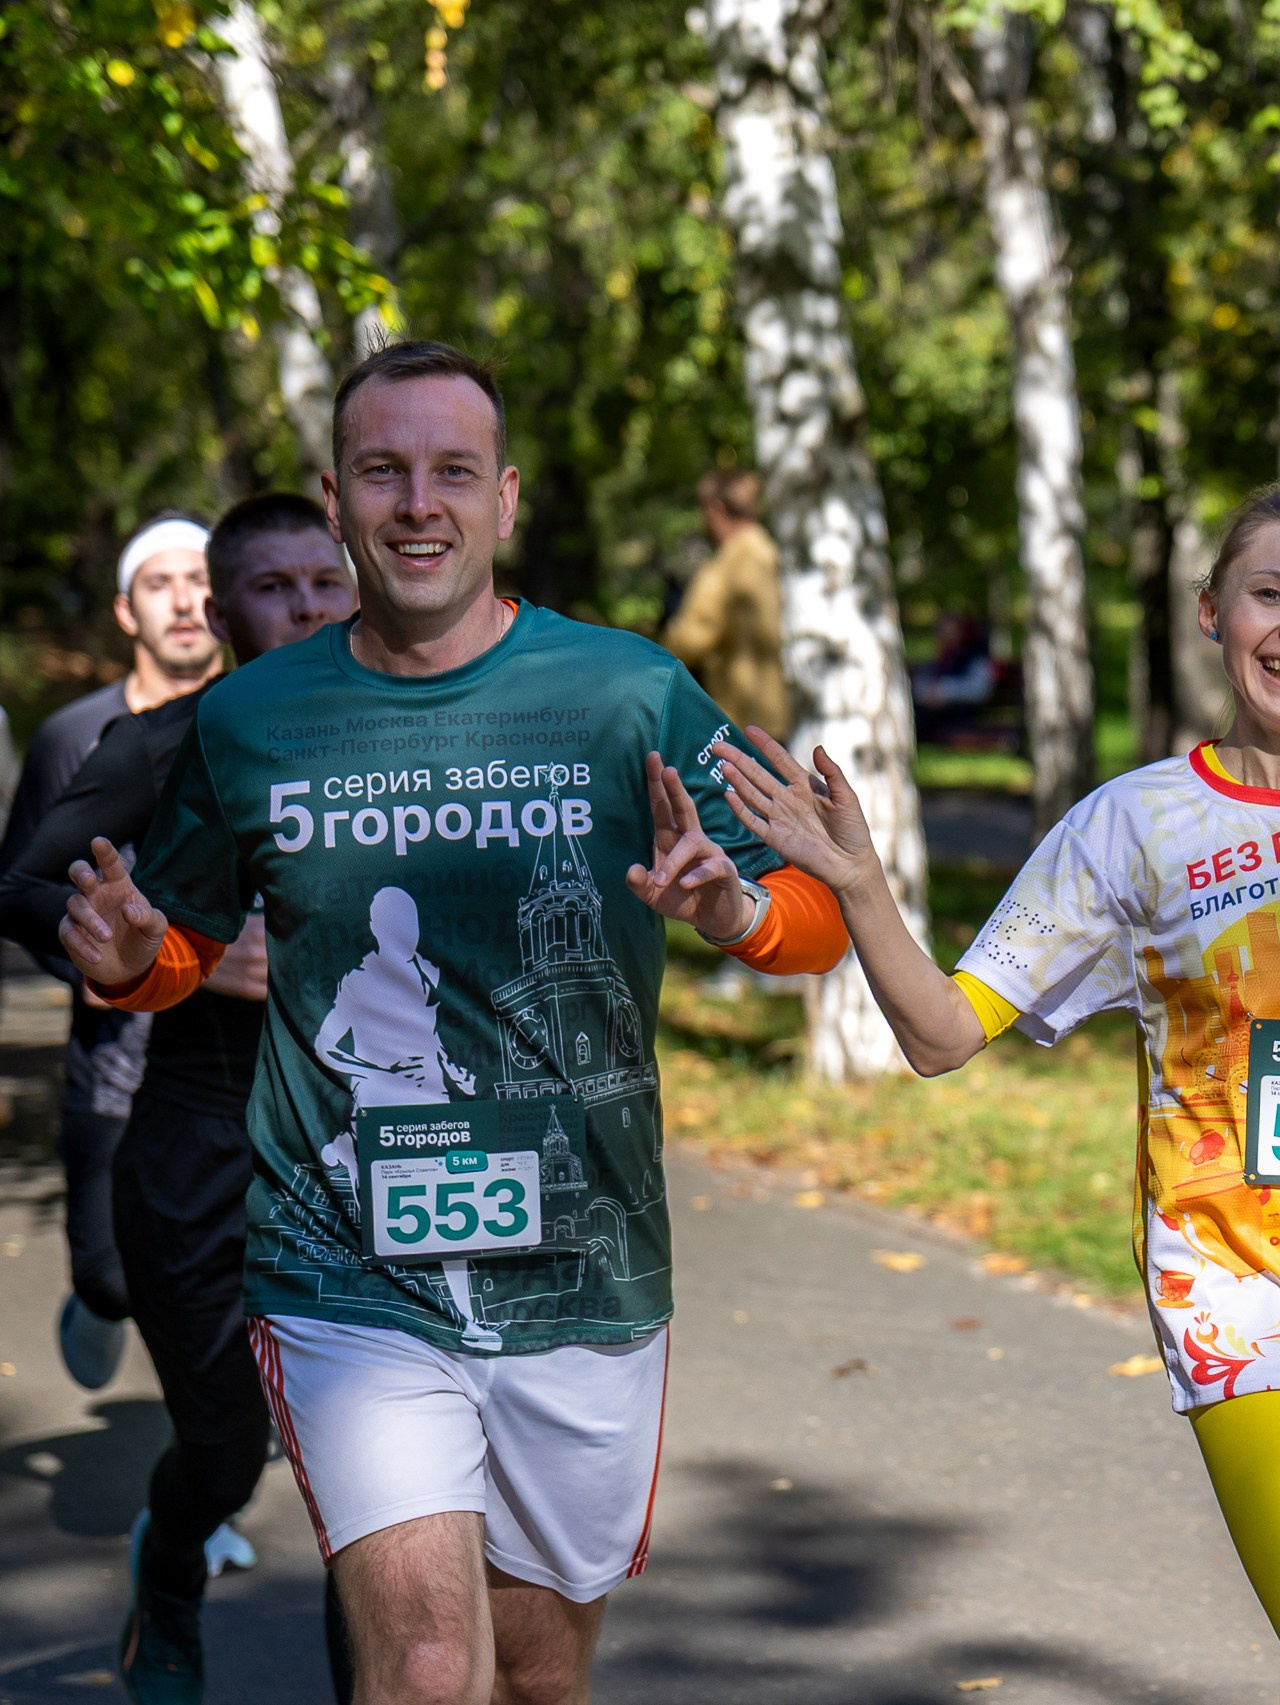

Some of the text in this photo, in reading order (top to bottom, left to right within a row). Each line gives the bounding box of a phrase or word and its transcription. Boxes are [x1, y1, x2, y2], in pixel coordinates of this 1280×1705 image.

[266, 705, 591, 742] Казань Москва Екатеринбург
[266, 728, 591, 764] Санкт-Петербург Краснодар
[323, 760, 591, 803] серия забегов
[269, 780, 314, 853] 5
[323, 798, 593, 856] городов
[1186, 840, 1263, 891] БЕЗ
[379, 1125, 396, 1147] 5
[396, 1120, 470, 1134] серия забегов
[397, 1130, 471, 1148] городов
[452, 1157, 478, 1166] 5 км
[386, 1178, 529, 1245] 553
